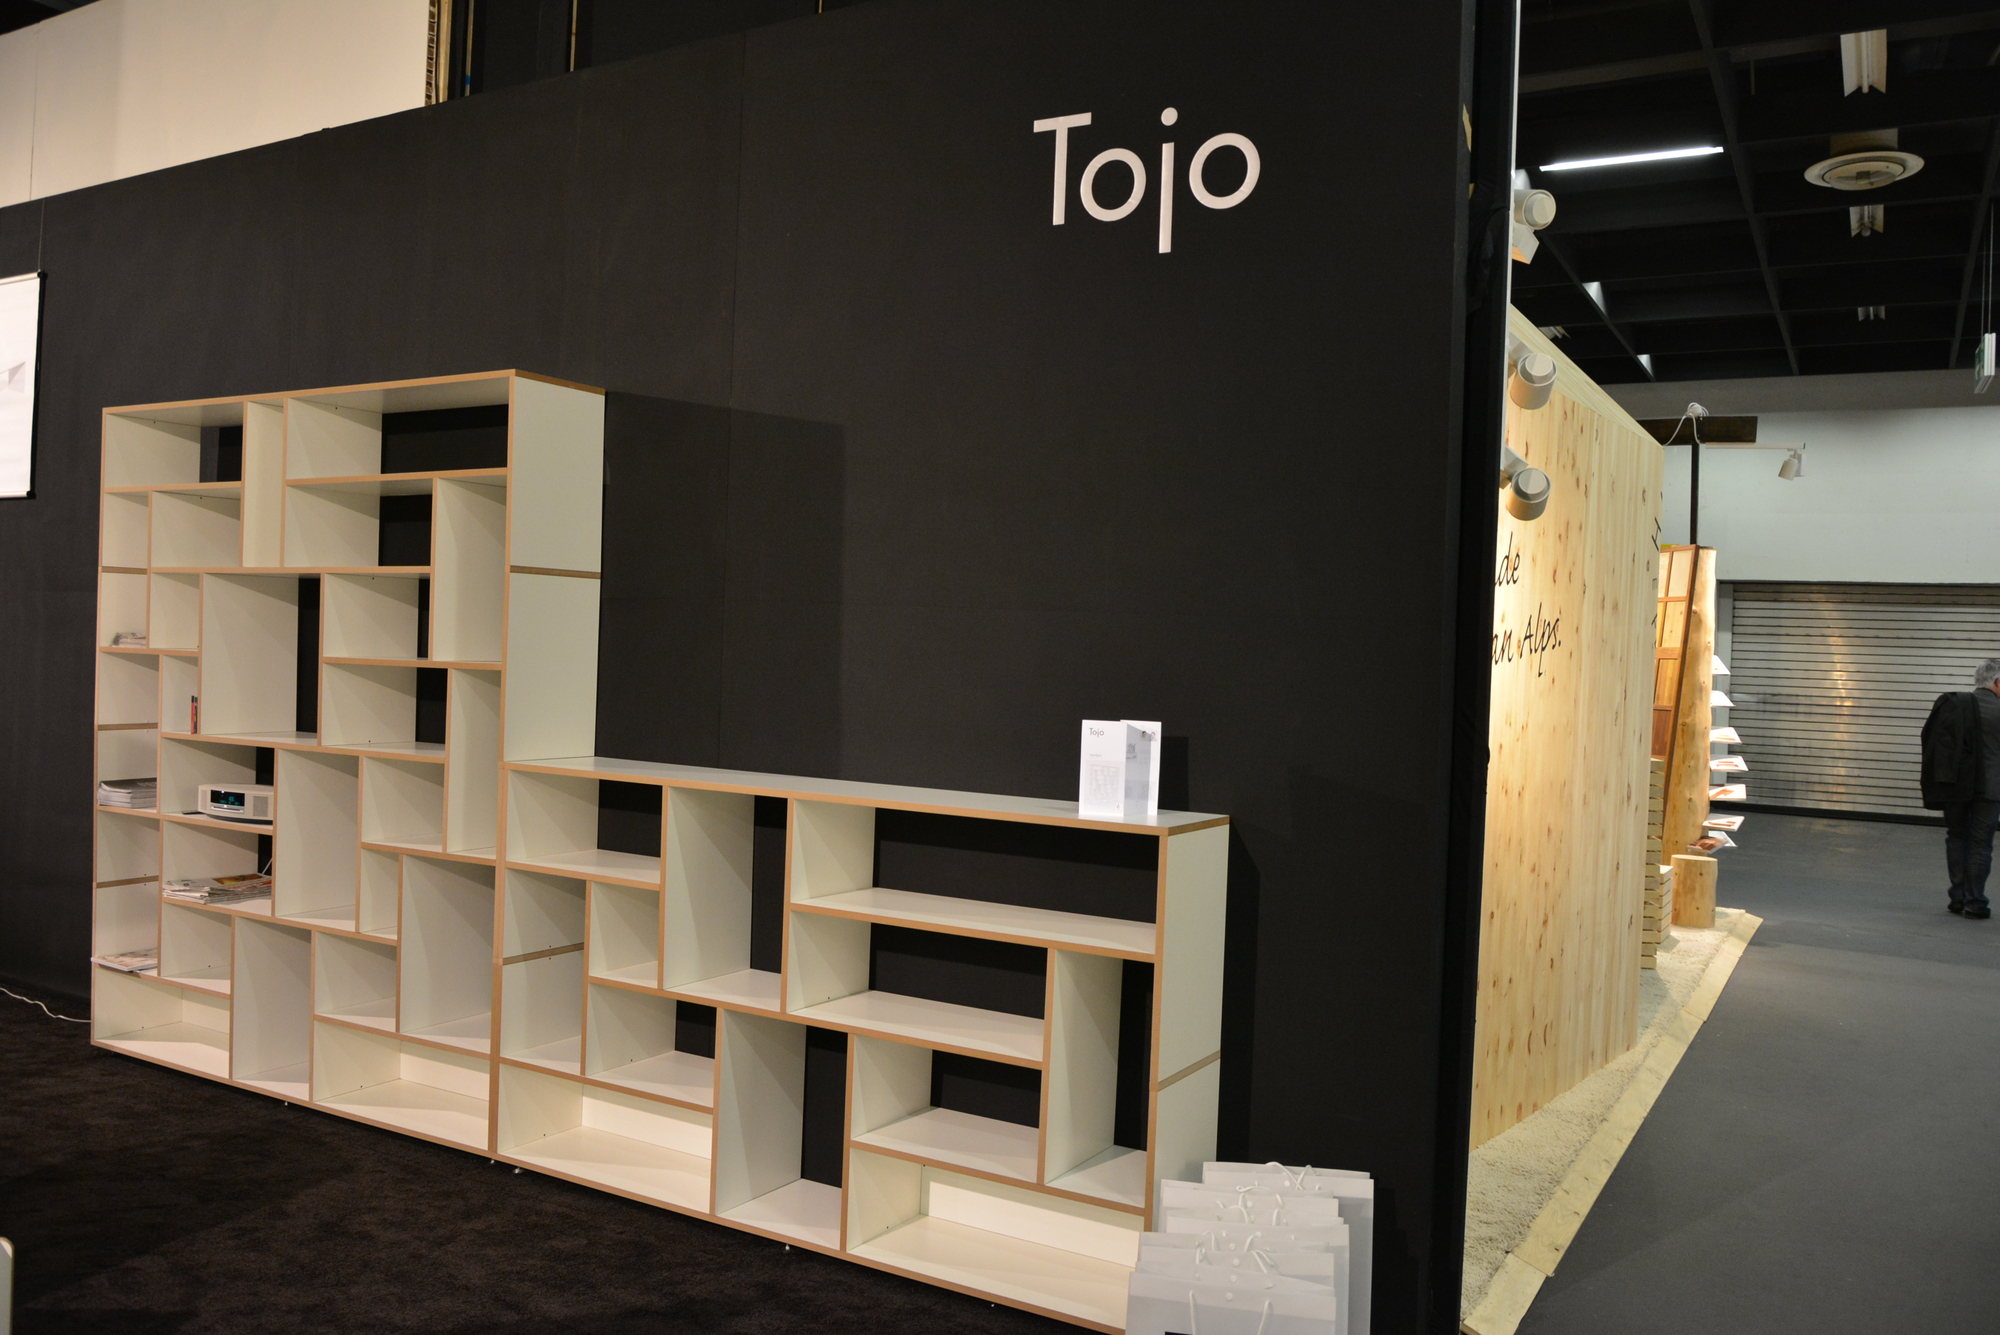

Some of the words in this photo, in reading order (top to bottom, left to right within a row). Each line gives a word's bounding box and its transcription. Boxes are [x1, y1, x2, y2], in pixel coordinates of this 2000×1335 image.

[1033, 107, 1261, 253] Tojo
[1494, 531, 1521, 587] de
[1519, 602, 1562, 678] Alps.
[1089, 727, 1105, 738] Tojo
